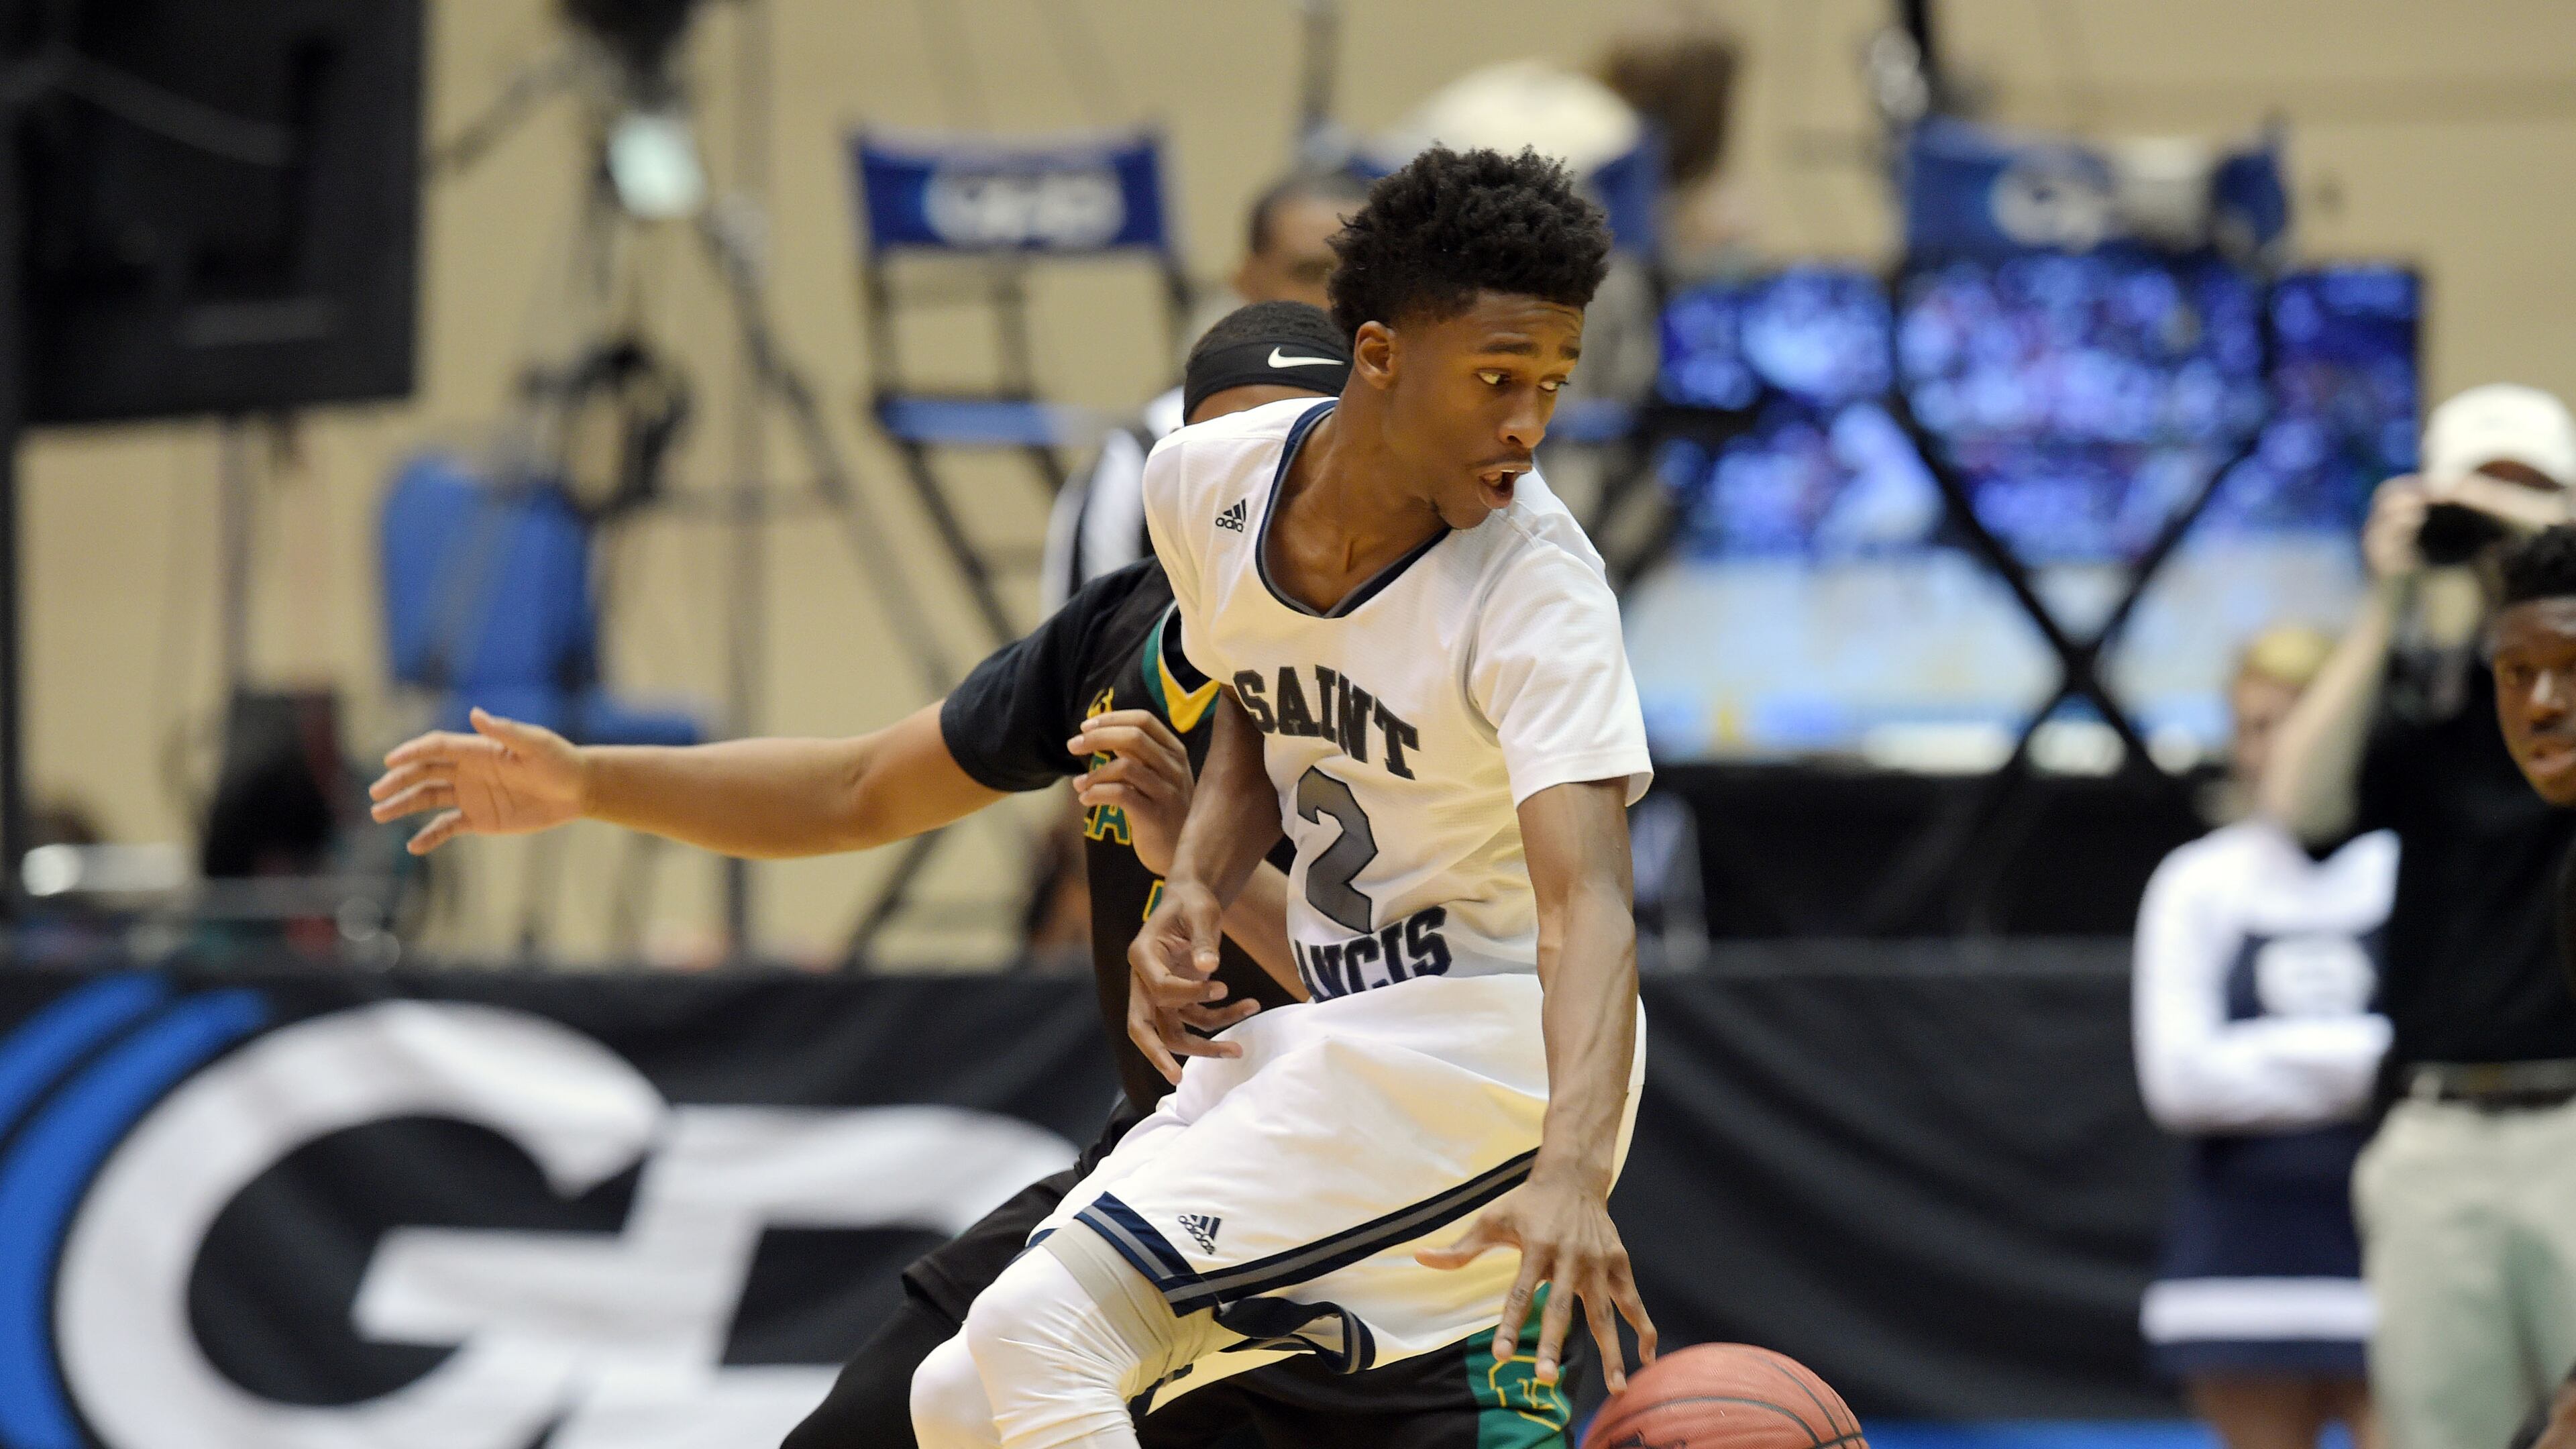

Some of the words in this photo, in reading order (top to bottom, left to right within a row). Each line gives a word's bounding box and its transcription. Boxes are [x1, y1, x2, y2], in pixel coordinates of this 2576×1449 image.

[1233, 664, 1420, 781] SAINT
[1297, 765, 1379, 934] 2
[1178, 1215, 1216, 1255] adidas
